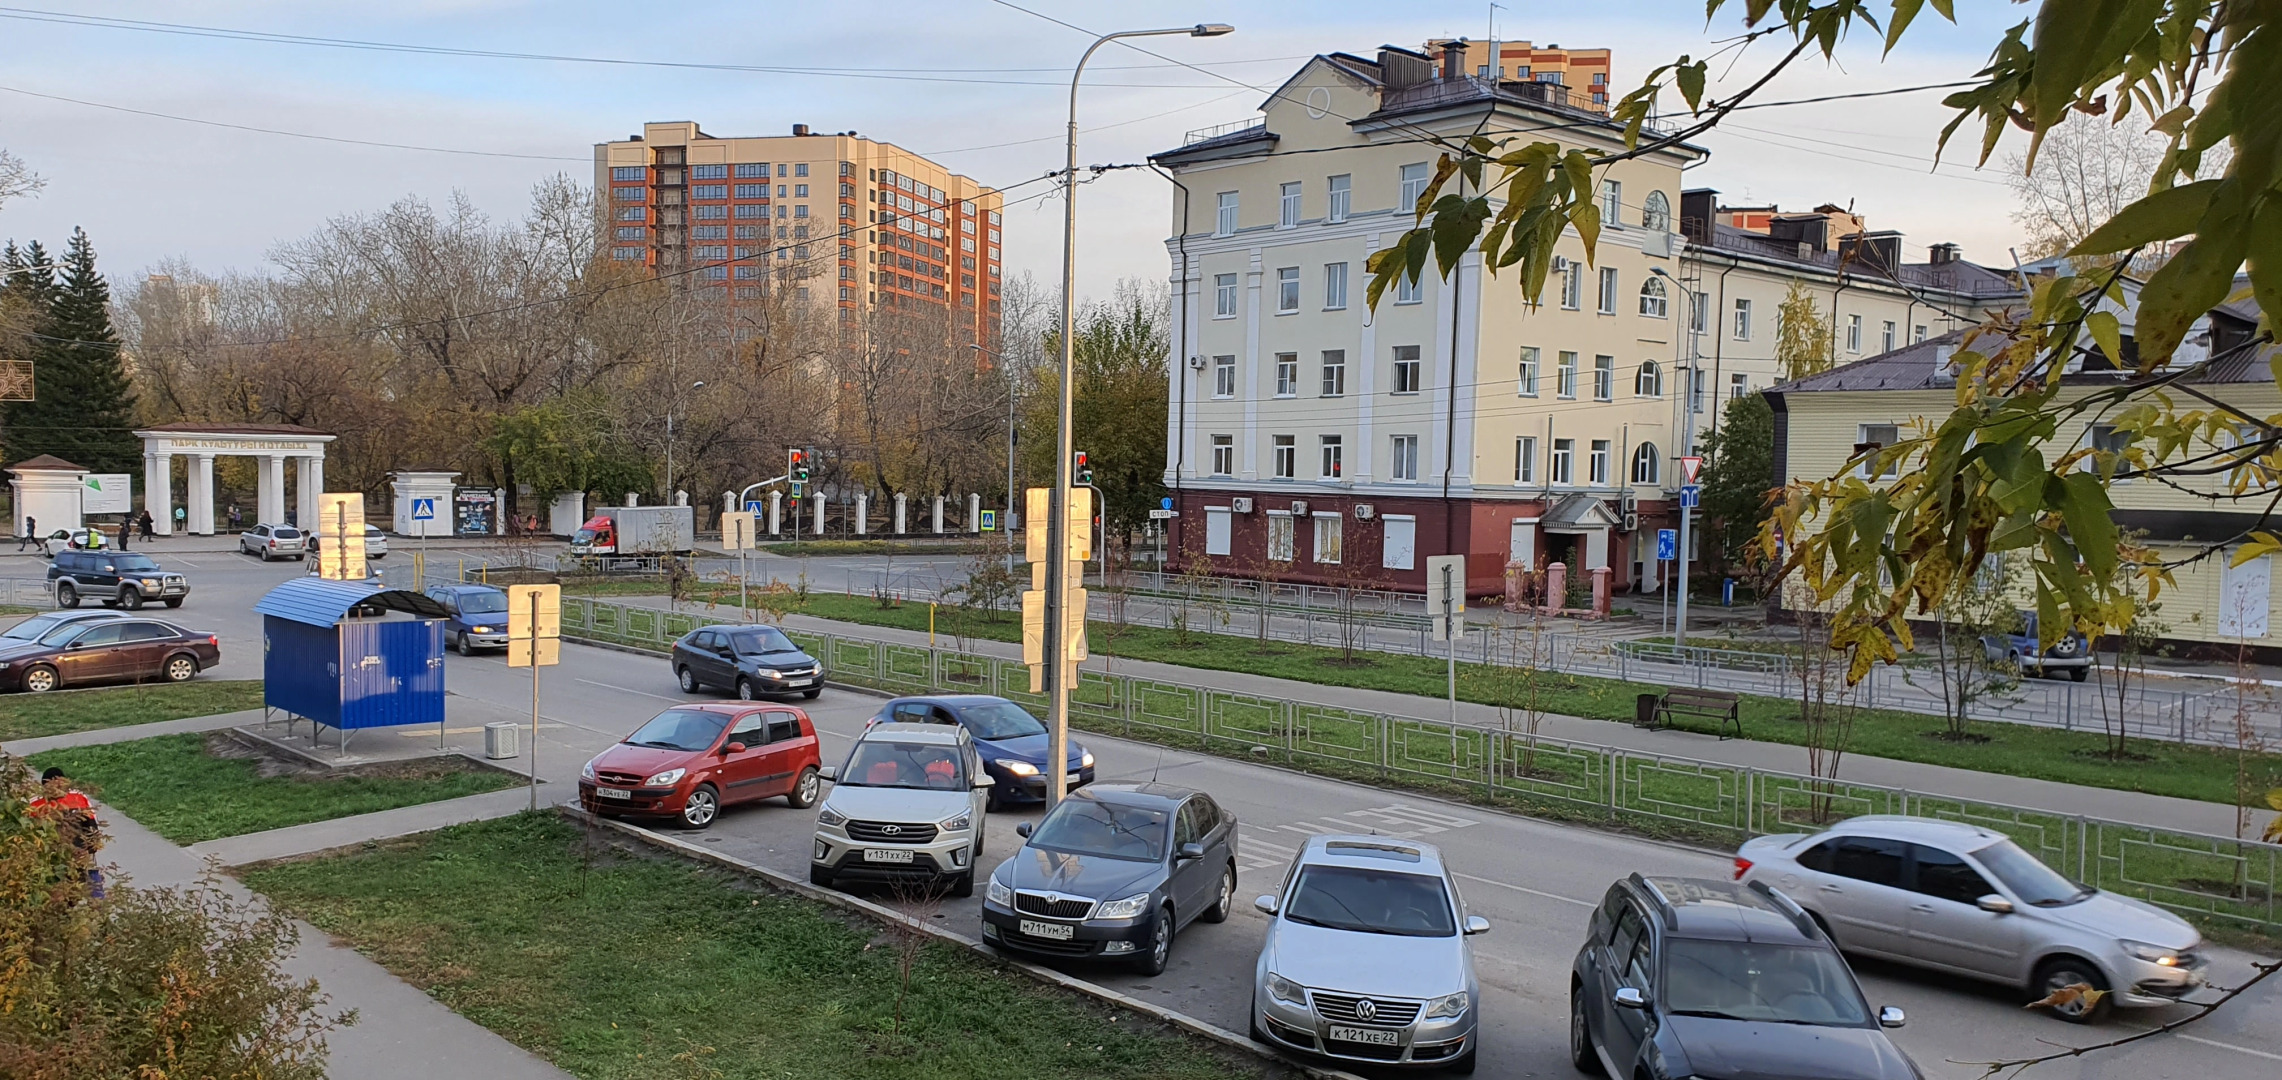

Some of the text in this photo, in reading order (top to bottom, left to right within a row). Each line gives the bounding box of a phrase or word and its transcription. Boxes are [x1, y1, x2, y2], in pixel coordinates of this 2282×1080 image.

[171, 439, 308, 449] ПАРК КУЛЬТУРЫ И ОТДЫХА
